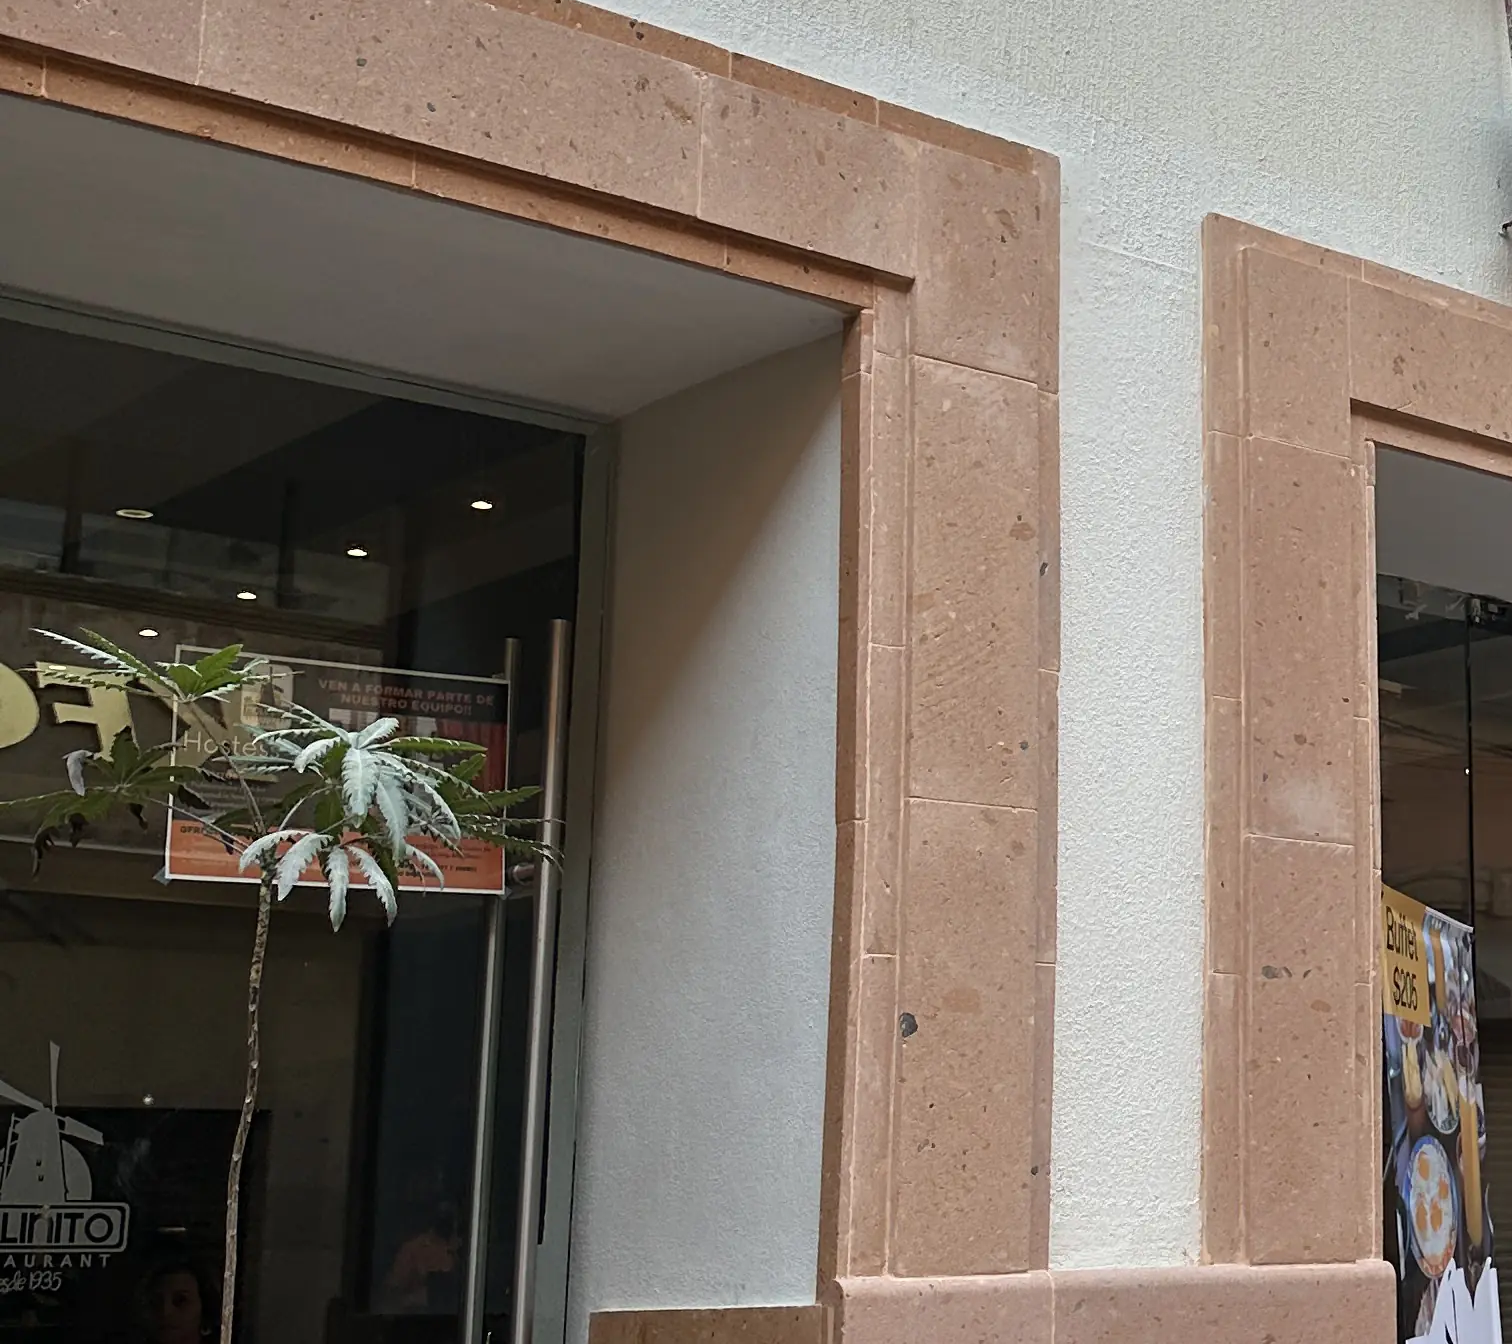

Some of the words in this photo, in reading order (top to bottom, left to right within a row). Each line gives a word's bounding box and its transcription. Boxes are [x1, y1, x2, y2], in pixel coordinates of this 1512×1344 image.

[317, 679, 347, 693] VEN
[365, 684, 423, 700] FORMAR
[427, 689, 472, 705] PARTE
[476, 694, 495, 707] DE
[340, 694, 408, 709] NUESTRO
[1385, 905, 1419, 962] Buffet
[1393, 964, 1418, 1012] $205
[29, 1270, 63, 1292] 1935
